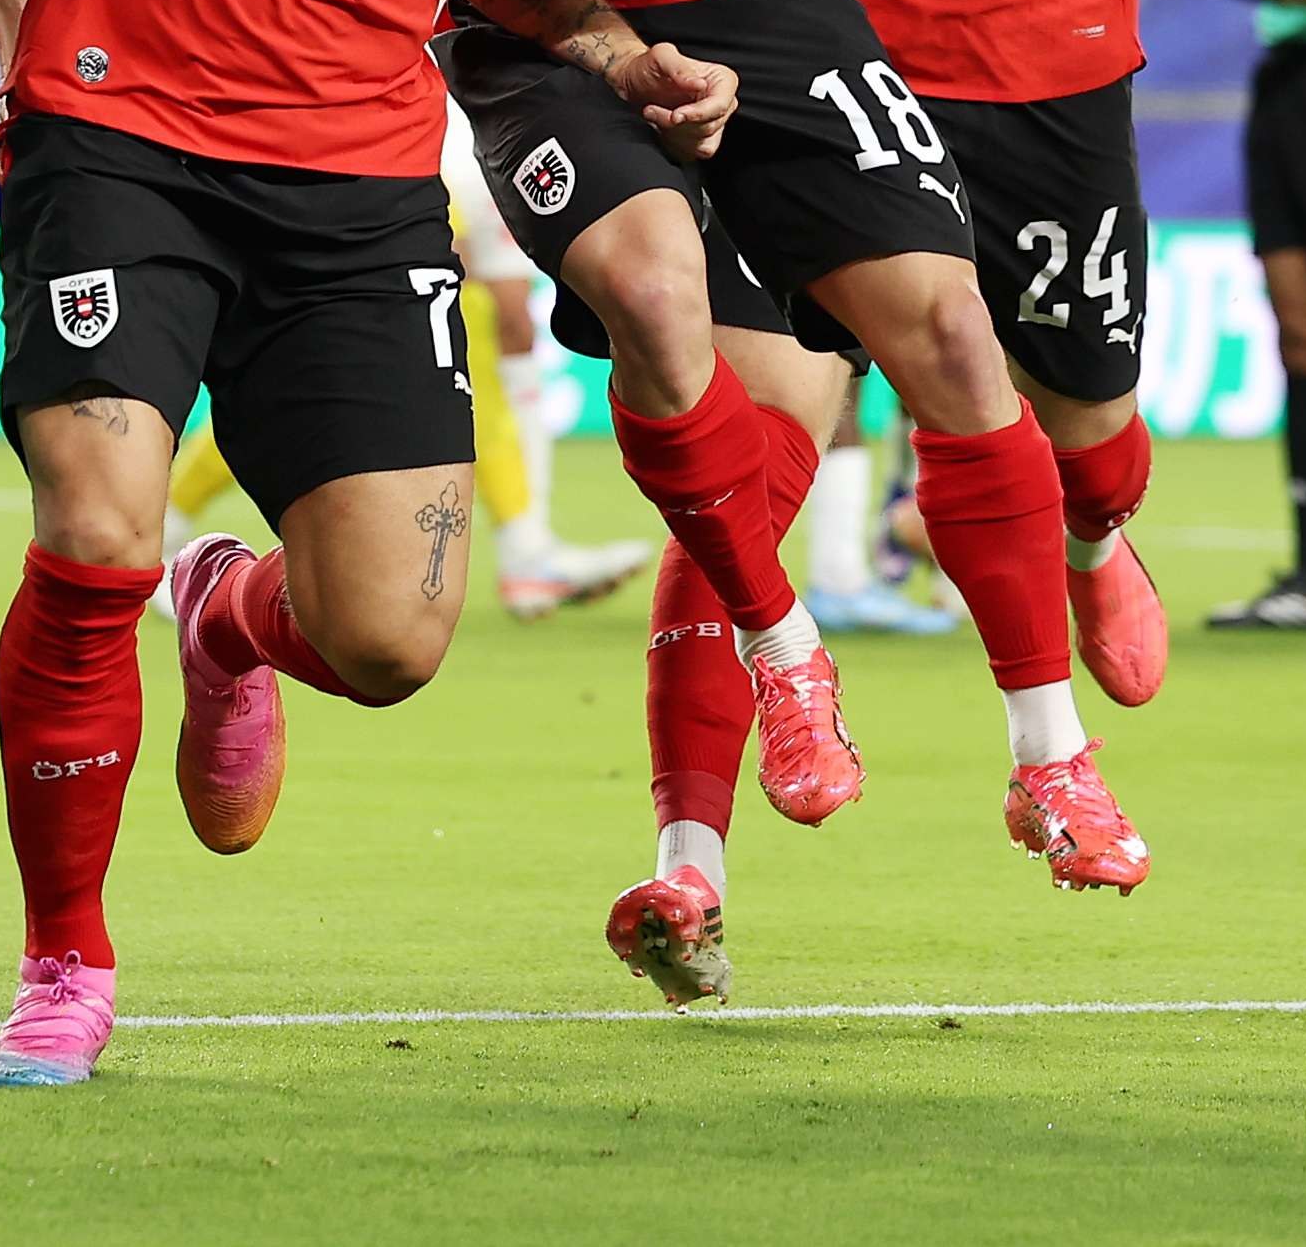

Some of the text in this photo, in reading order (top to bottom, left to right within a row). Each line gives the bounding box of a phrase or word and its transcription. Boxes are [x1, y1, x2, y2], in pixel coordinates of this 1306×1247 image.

[808, 59, 945, 172] 18
[408, 267, 460, 369] 7
[1016, 206, 1131, 330] 24
[31, 750, 121, 781] ÖFB
